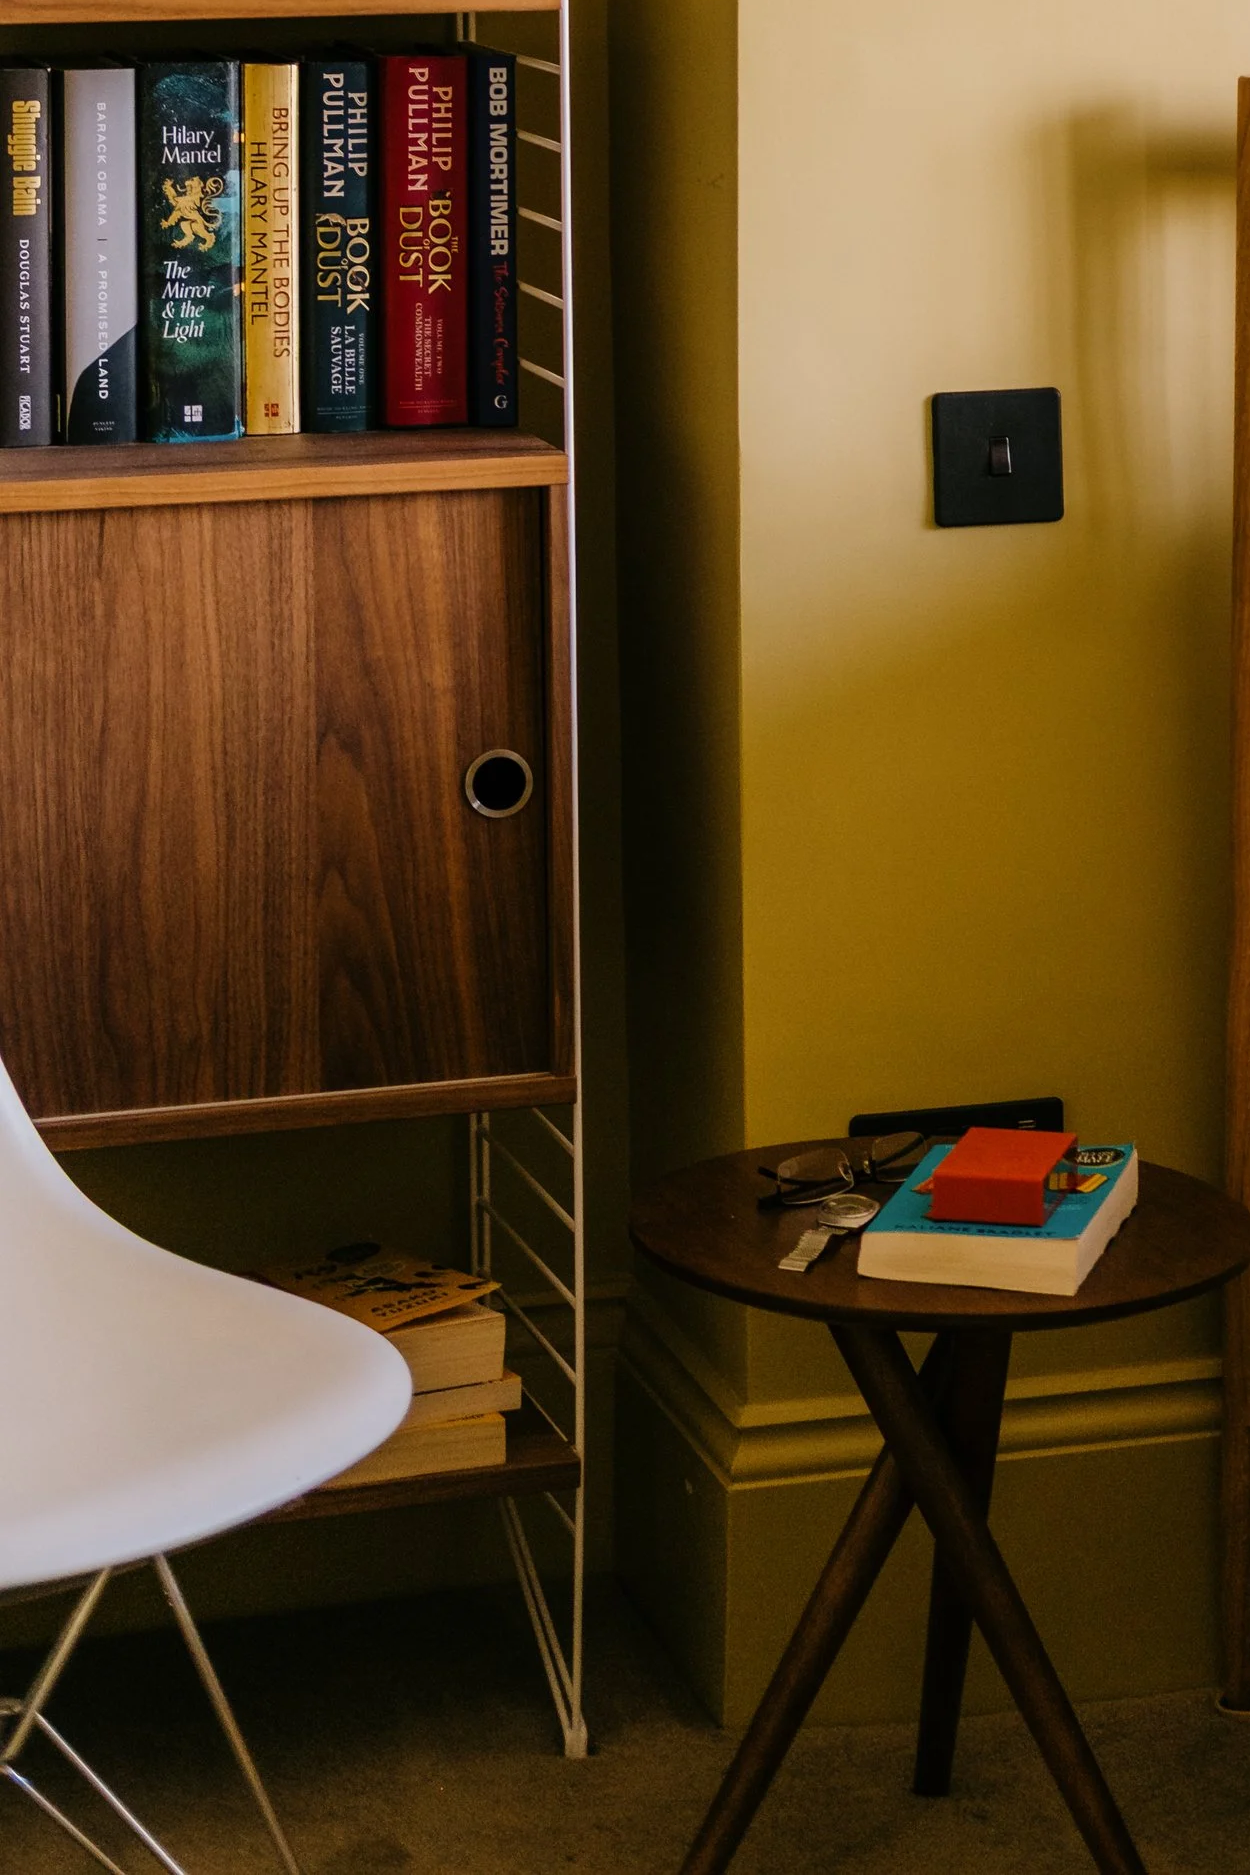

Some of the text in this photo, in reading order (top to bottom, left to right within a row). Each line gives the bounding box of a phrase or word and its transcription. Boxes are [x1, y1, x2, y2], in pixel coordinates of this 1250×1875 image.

[6, 100, 41, 217] Shuggie Bain
[96, 102, 107, 226] BARACK OBAMA
[161, 145, 221, 164] Mantel
[163, 126, 214, 148] Hilary
[322, 72, 344, 197] PULLMAN
[347, 92, 367, 177] PHILIP
[408, 67, 428, 191] PULLMAN
[432, 86, 453, 171] PHILIP
[488, 67, 509, 256] BOB MORTIMER
[163, 261, 191, 279] The
[250, 142, 268, 324] HILARY MANTEL
[272, 107, 291, 358] BRING UP THE BODIES
[316, 226, 342, 307] DUST
[346, 218, 370, 315] BOOK
[399, 206, 423, 288] DUST
[428, 199, 452, 295] BOOK
[19, 239, 31, 374] DOUGLAS STUART
[97, 253, 109, 399] A PROMISED LAND
[161, 283, 215, 299] Mirror
[162, 301, 205, 318] & the
[163, 320, 205, 342] Light
[330, 326, 343, 394] SAUVAGE
[344, 325, 357, 395] LA BELLE
[414, 302, 424, 392] COMMONWEALTH
[424, 317, 432, 378] THE SECRET
[19, 395, 31, 430] PICADOR
